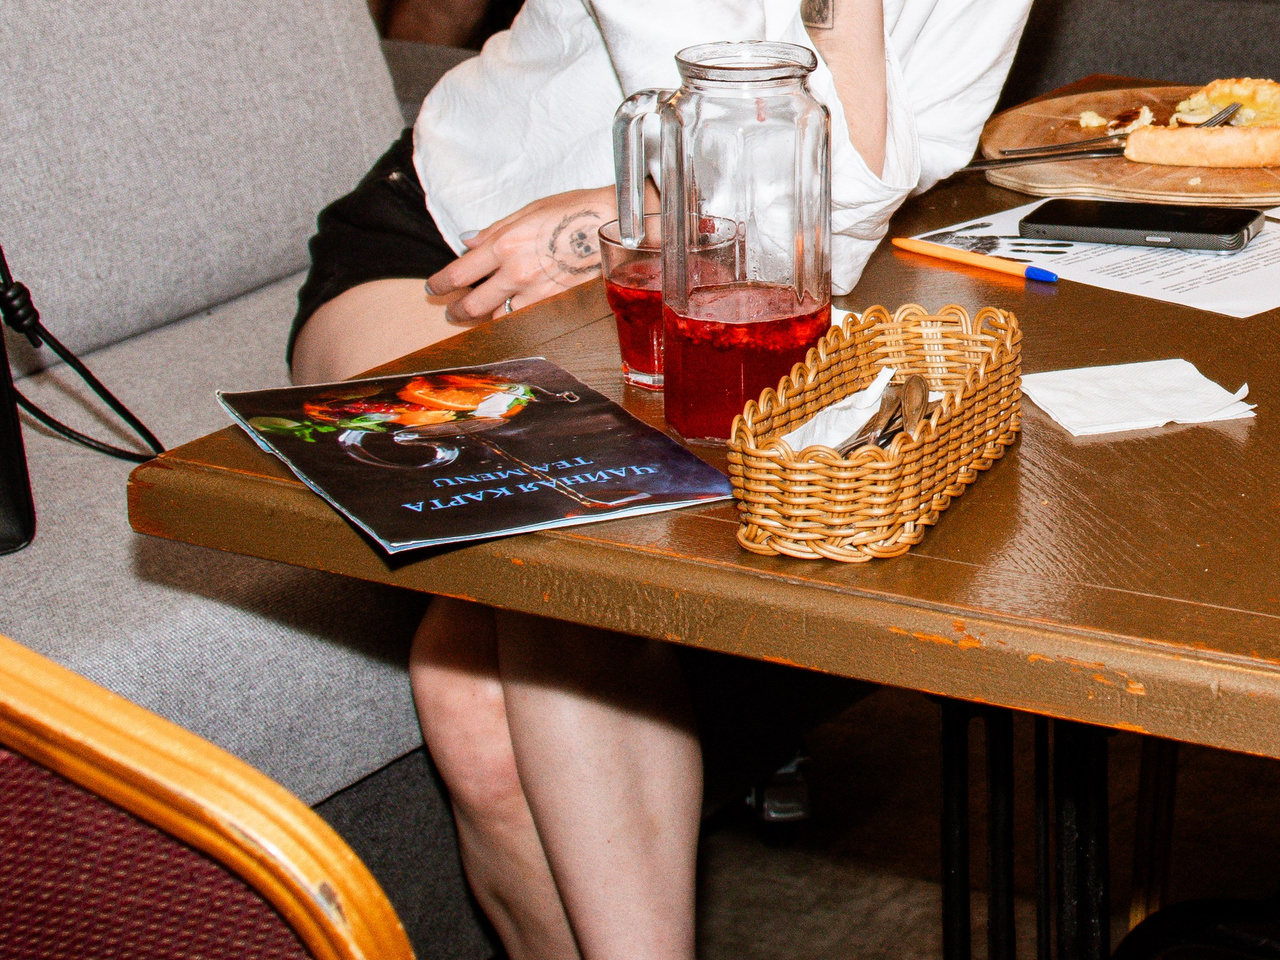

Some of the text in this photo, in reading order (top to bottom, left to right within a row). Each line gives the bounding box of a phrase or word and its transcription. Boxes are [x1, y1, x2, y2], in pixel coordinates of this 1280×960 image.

[401, 464, 656, 512] ЧАЙНАЯ КАРТА
[432, 456, 594, 488] TEA MENU
